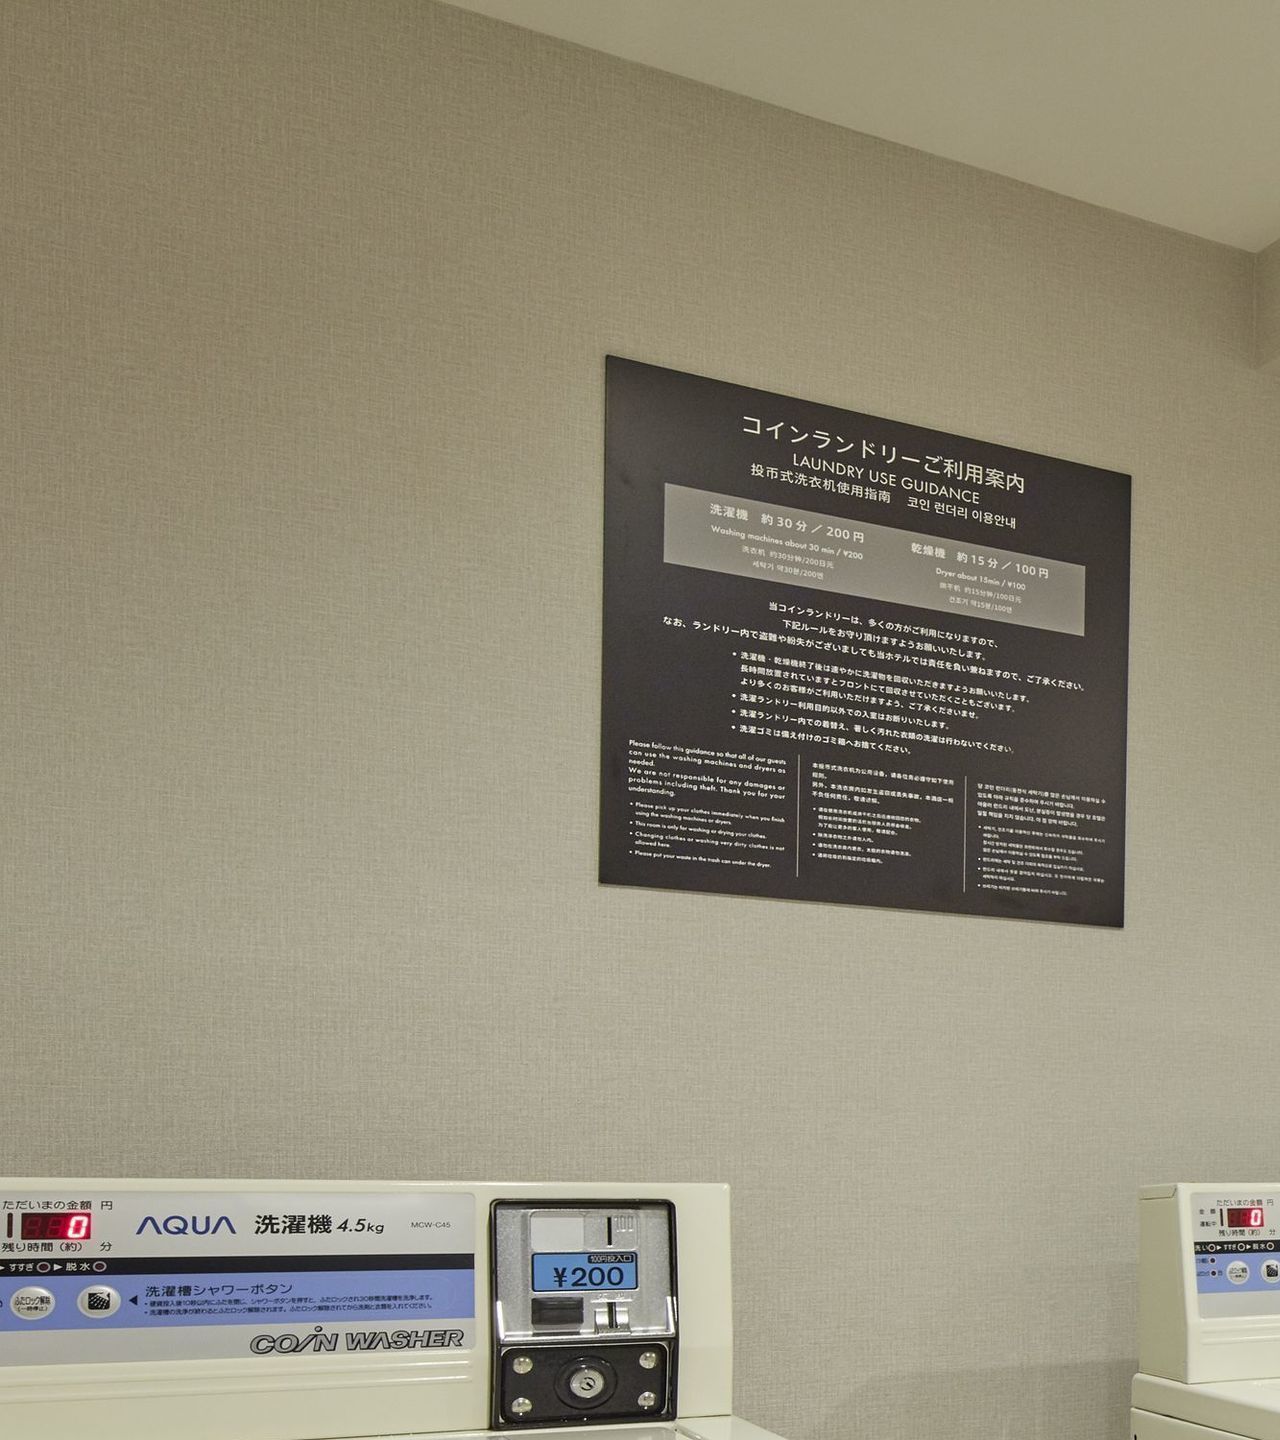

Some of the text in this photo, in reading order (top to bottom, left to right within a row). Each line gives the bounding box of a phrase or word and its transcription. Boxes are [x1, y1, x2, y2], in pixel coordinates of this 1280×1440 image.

[742, 411, 1024, 494] コインランドリーご利用案内
[750, 461, 890, 504] 投币式洗衣机使用指南
[793, 452, 979, 505] LAUNDRY USE GUIDANCE
[709, 502, 749, 521] 洗濯機
[907, 494, 1016, 530] 코인 런더리 이용안내
[710, 523, 863, 561] Washing machines about 30 min ¥200
[910, 541, 946, 559] 乾燥機
[935, 566, 1026, 591] Dryer about 15min ¥100
[628, 738, 650, 748] Please
[651, 741, 672, 751] follow
[672, 744, 684, 752] this
[684, 745, 715, 758] guidance
[724, 750, 737, 759] that
[737, 752, 746, 760] all
[747, 753, 754, 761] of
[766, 757, 786, 767] guests
[628, 756, 655, 767] needed.
[658, 751, 670, 760] the
[672, 753, 702, 765] washing
[703, 757, 737, 768] machines
[738, 761, 752, 770] and
[753, 763, 776, 774] dryers
[627, 766, 642, 774] We
[658, 770, 671, 778] not
[672, 771, 714, 784] responsible
[715, 775, 727, 784] for
[728, 779, 742, 787] any
[743, 779, 776, 791] damages
[627, 774, 785, 801] problems including theft. Thank you for your
[627, 783, 675, 798] understanding.
[2, 1200, 113, 1210] ただいまの金額 円
[67, 1215, 89, 1238] 0
[136, 1215, 237, 1235] AQUA
[254, 1213, 385, 1236] 洗濯機 4.5kg
[1250, 1209, 1261, 1226] 0
[100, 1242, 112, 1252] 分
[9, 1263, 34, 1272] すすぎ
[65, 1262, 91, 1272] 脱水
[553, 1266, 625, 1287] ¥200
[145, 1283, 293, 1298] 洗濯槽シャワーボタン
[346, 1329, 464, 1350] WASHER
